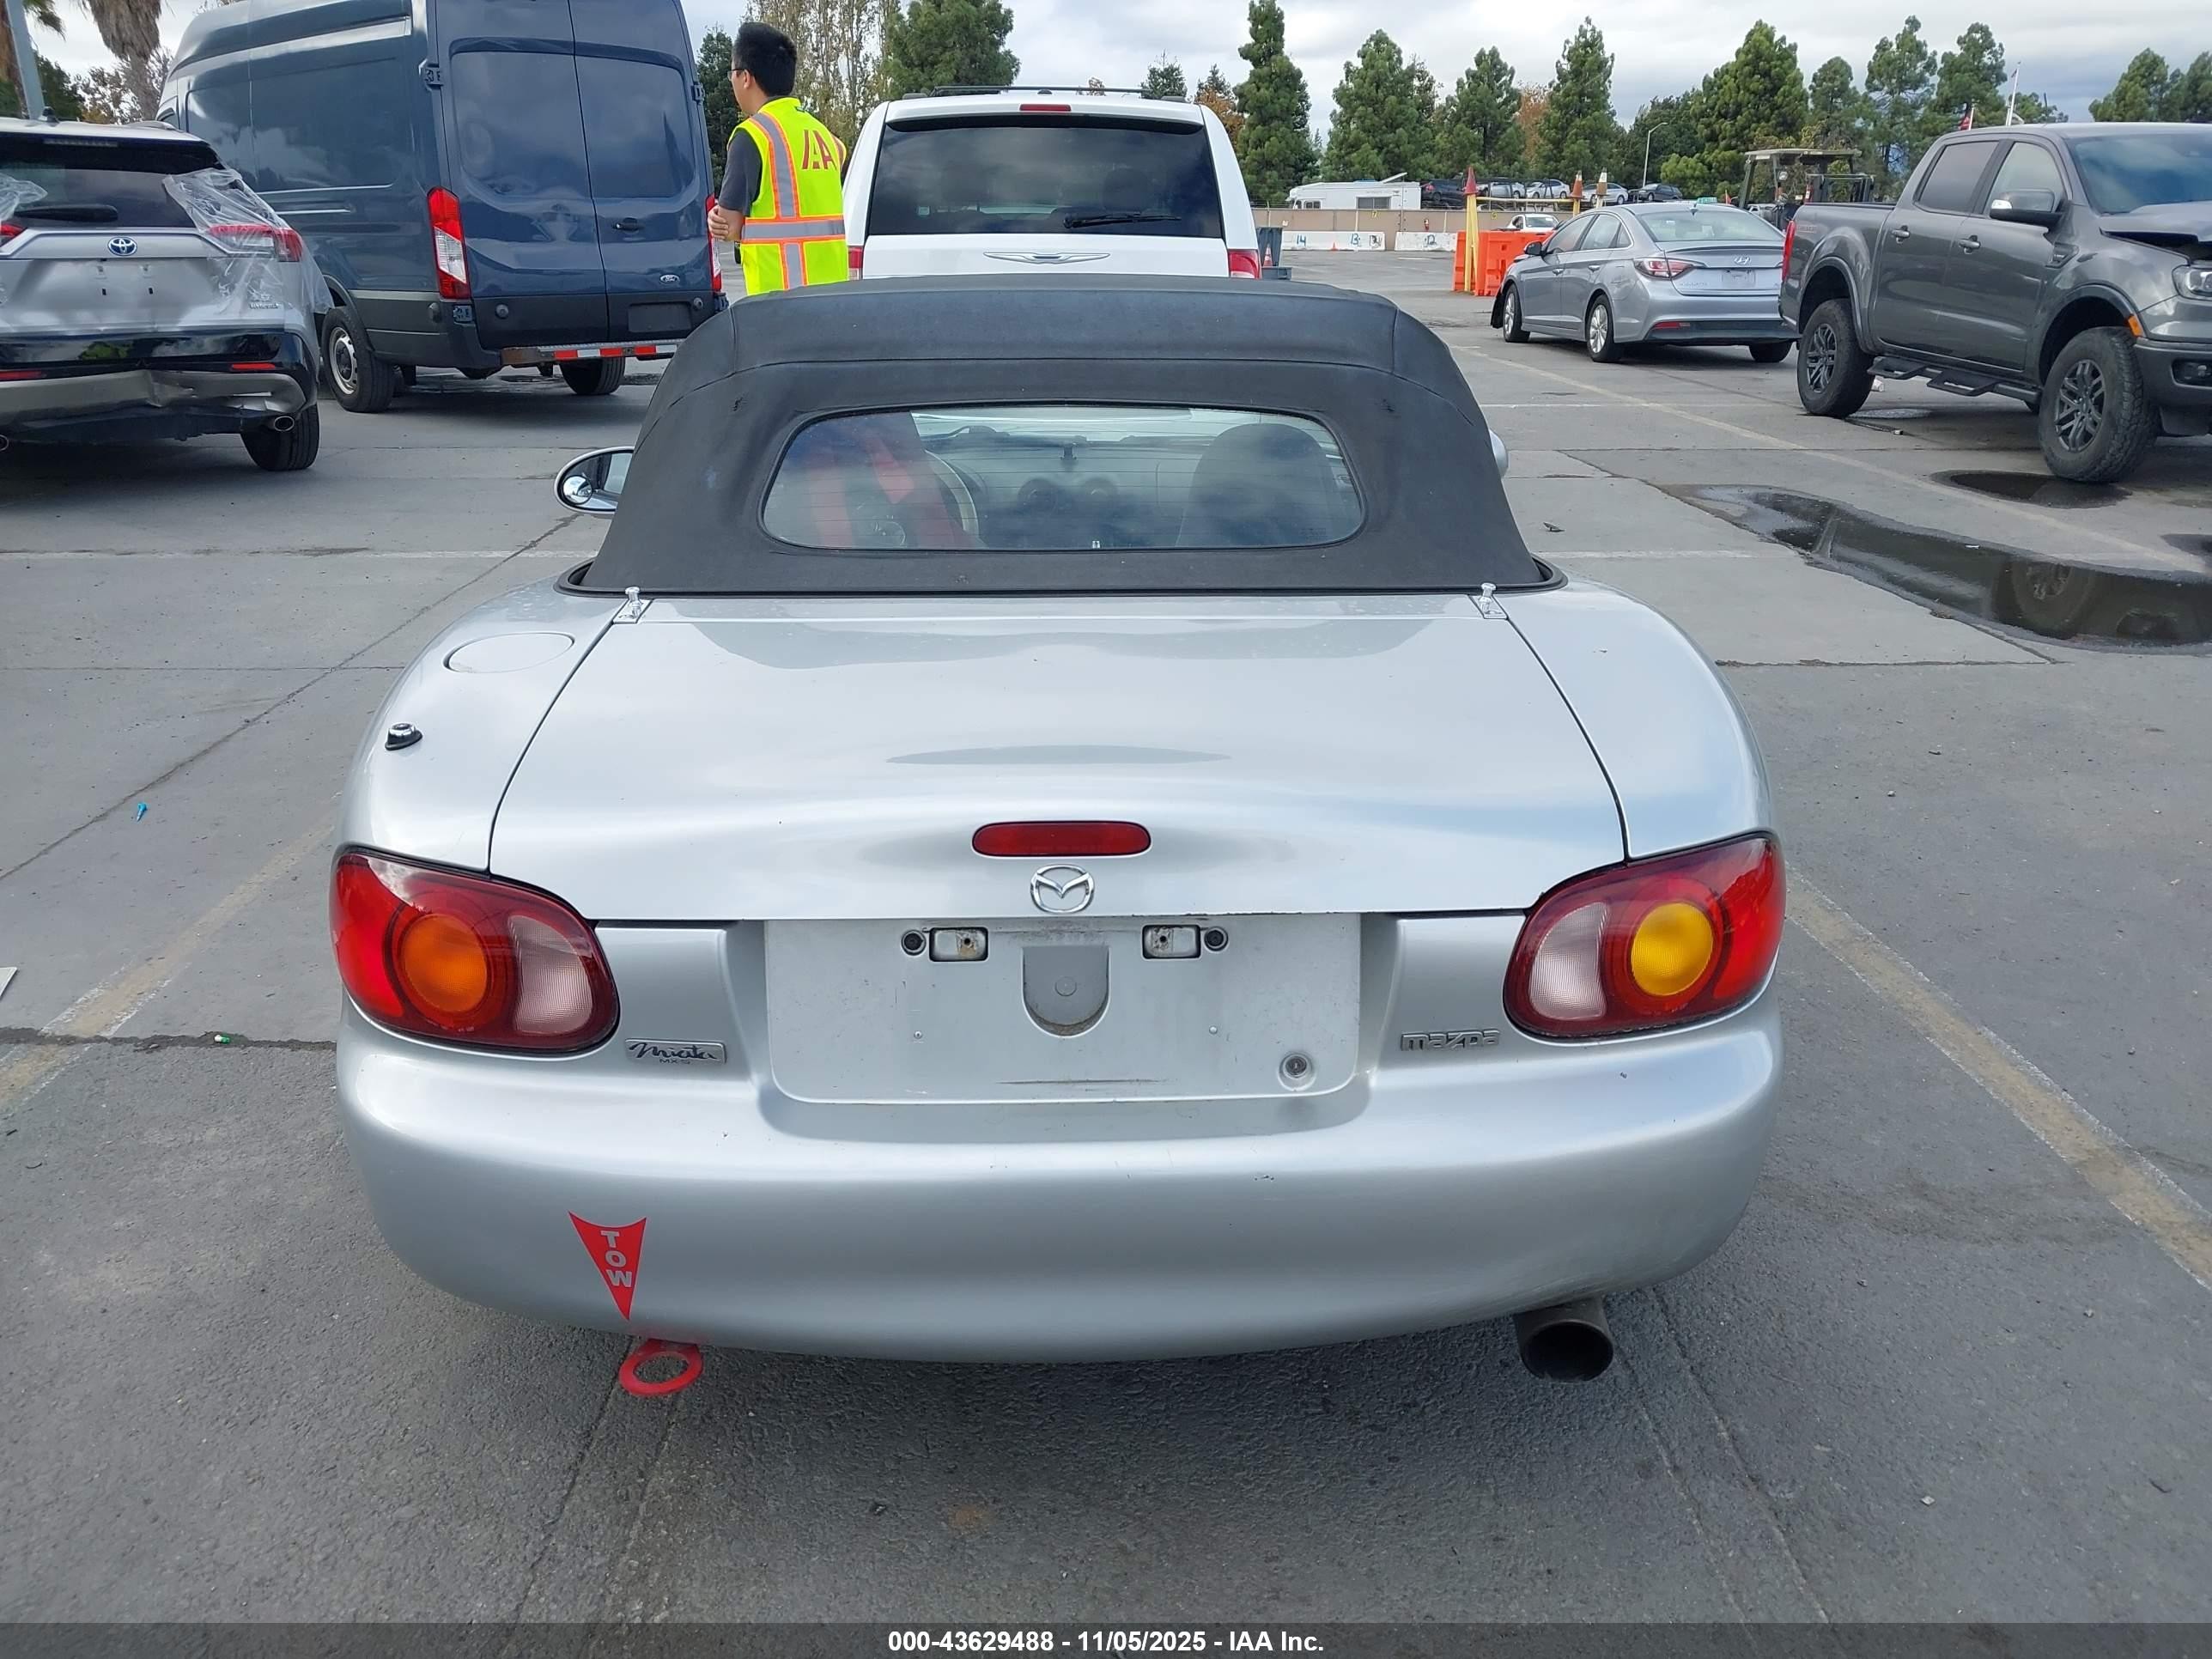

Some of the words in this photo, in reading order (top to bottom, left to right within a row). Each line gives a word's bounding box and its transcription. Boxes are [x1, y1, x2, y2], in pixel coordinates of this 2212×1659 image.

[1297, 234, 1306, 246] 14
[629, 1042, 718, 1059] Miata
[601, 1230, 633, 1288] TOW
